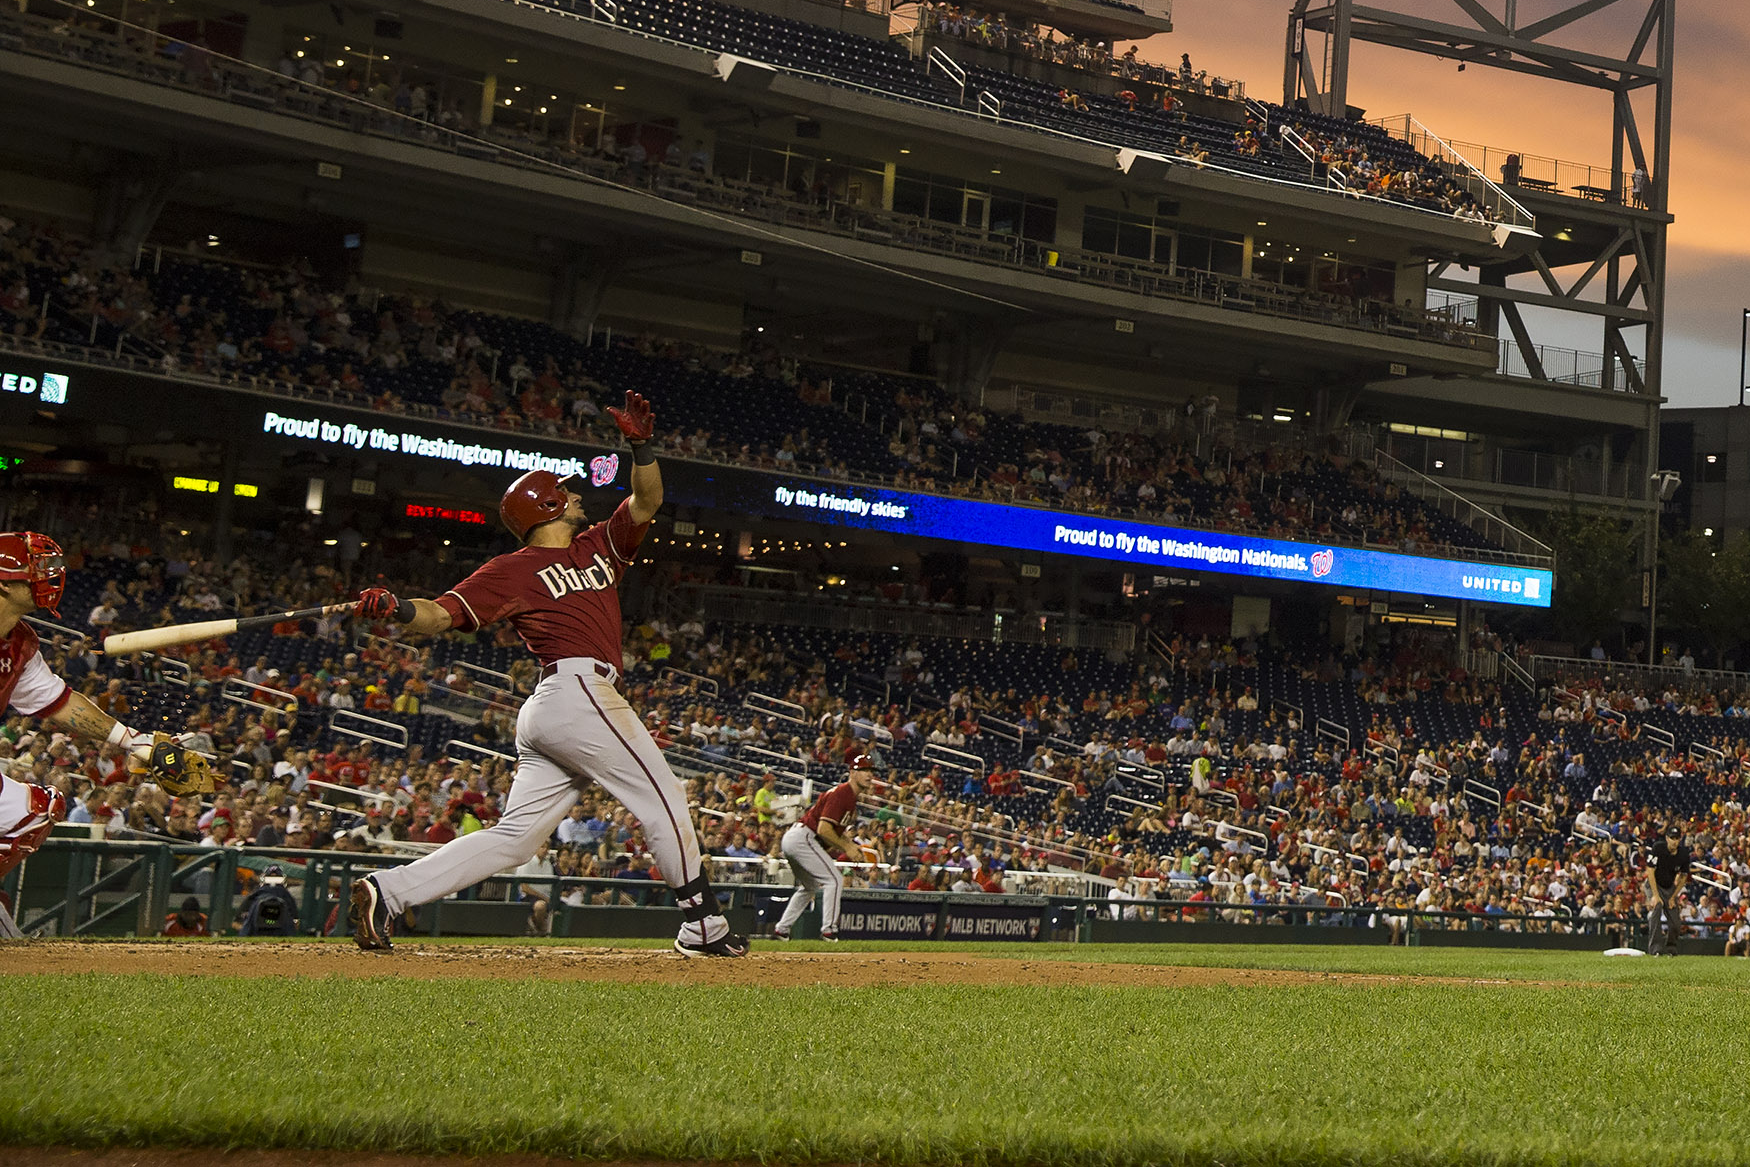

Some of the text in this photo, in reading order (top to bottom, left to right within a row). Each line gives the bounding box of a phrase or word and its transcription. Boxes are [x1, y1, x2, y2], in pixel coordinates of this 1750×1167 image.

[0, 373, 37, 394] ED
[263, 412, 320, 439] Proud
[321, 421, 341, 443] to
[342, 423, 368, 450] fly
[369, 428, 399, 452] the
[401, 433, 502, 466] Washington
[775, 486, 906, 519] fly the friendly skies
[1054, 524, 1308, 572] Proud to fly the Washington Nationals.
[1462, 575, 1522, 594] UNITED
[840, 913, 922, 933] MLB NETWORK
[952, 917, 1027, 936] MLB NETWORK
